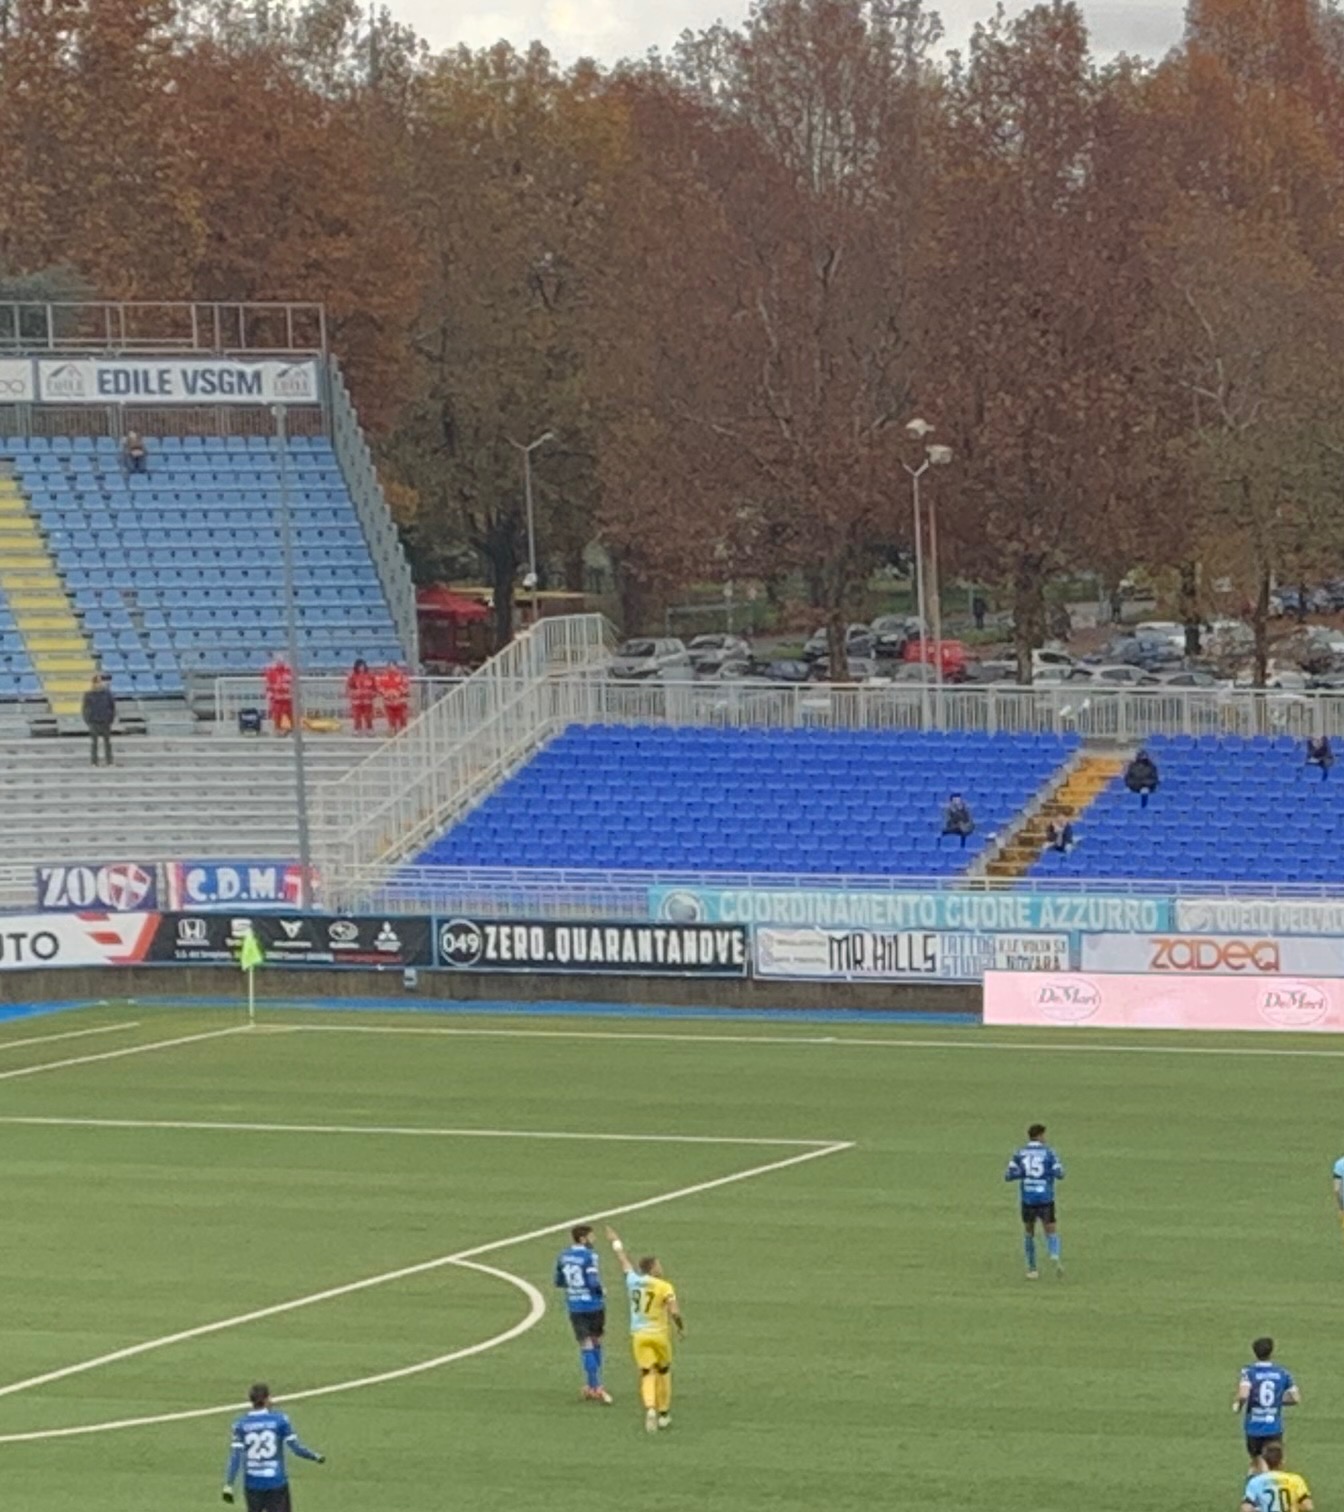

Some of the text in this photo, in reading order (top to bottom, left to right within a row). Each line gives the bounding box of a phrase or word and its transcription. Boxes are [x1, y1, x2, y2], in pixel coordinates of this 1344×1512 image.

[97, 368, 263, 395] EDILE VSGM
[186, 867, 286, 901] C.D.M.
[720, 891, 1158, 931] COORDINAMENTO CUORE AZZURRO
[0, 931, 60, 961] TO
[442, 932, 480, 954] 049
[484, 926, 744, 964] ZERO.QUARANTANOVE
[1021, 1155, 1045, 1178] 15
[1258, 1380, 1276, 1408] 6
[244, 1430, 278, 1460] 23
